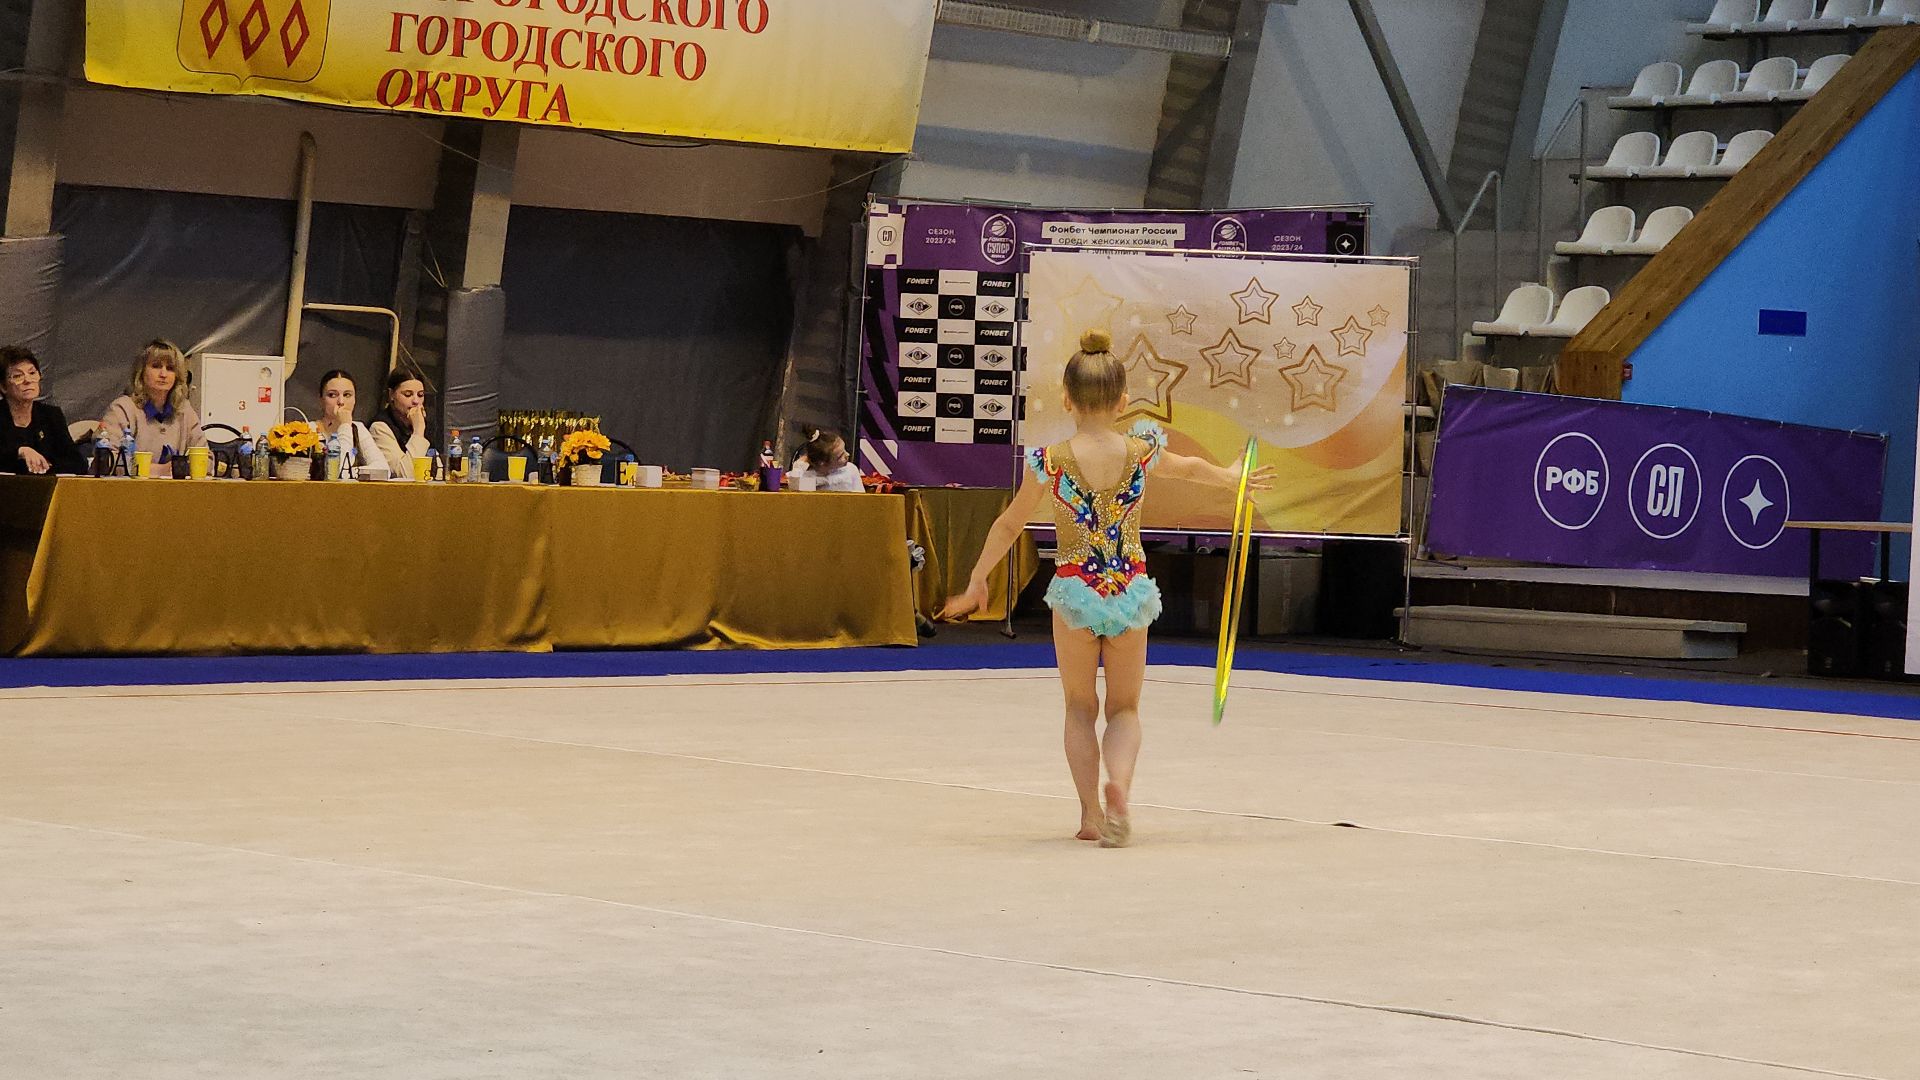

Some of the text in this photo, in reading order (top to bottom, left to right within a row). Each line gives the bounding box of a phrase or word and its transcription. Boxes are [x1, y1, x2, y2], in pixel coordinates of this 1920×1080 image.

[386, 12, 706, 81] ГОРОДСКОГО
[376, 68, 572, 123] ОКРУГА
[927, 228, 955, 236] СЕЗОН
[1049, 225, 1178, 235] Фонбет Чемпионат России
[882, 230, 893, 242] СЛ
[1058, 237, 1168, 246] среди женских команд
[1271, 244, 1304, 252] 2023/24
[906, 277, 934, 285] FONBET
[982, 280, 1011, 288] FONBET
[904, 326, 934, 334] FONBET
[979, 329, 1010, 337] FONBET
[903, 376, 932, 384] FONBET
[980, 379, 1008, 387] FONBET
[238, 400, 246, 411] 3
[902, 425, 931, 433] FONBET
[979, 427, 1008, 435] FONBET
[1545, 466, 1600, 496] РФБ
[1646, 464, 1685, 518] СЛ
